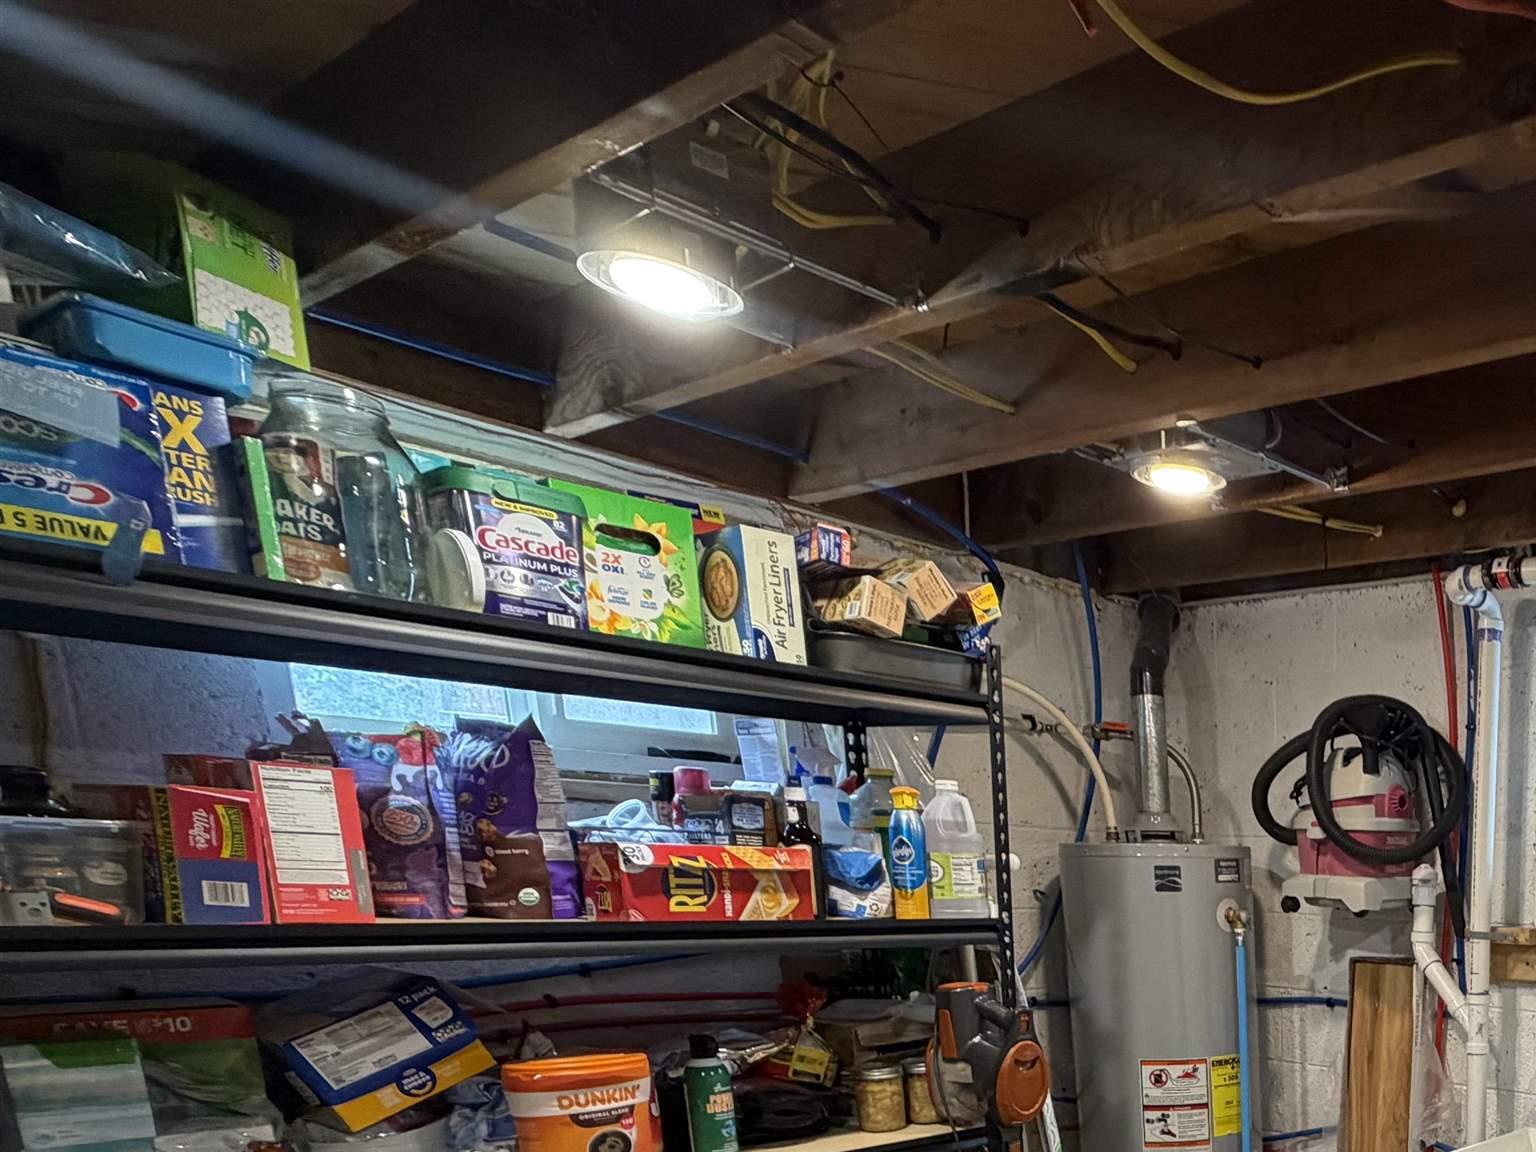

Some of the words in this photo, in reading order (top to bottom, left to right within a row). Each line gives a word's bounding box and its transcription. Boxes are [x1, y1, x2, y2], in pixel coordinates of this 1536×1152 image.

[155, 407, 209, 456] X
[12, 510, 26, 527] 5
[33, 513, 108, 541] VALUE
[478, 527, 578, 565] Cascade
[602, 552, 622, 565] 2X
[482, 551, 548, 572] PLATINUM
[549, 563, 578, 578] PLUS
[602, 564, 624, 575] OXI
[768, 540, 783, 588] Liners
[773, 588, 788, 629] Fryer
[775, 630, 788, 650] Air
[188, 809, 211, 850] Wafer
[668, 854, 708, 912] RITZ
[557, 1083, 641, 1111] DUNKIN'
